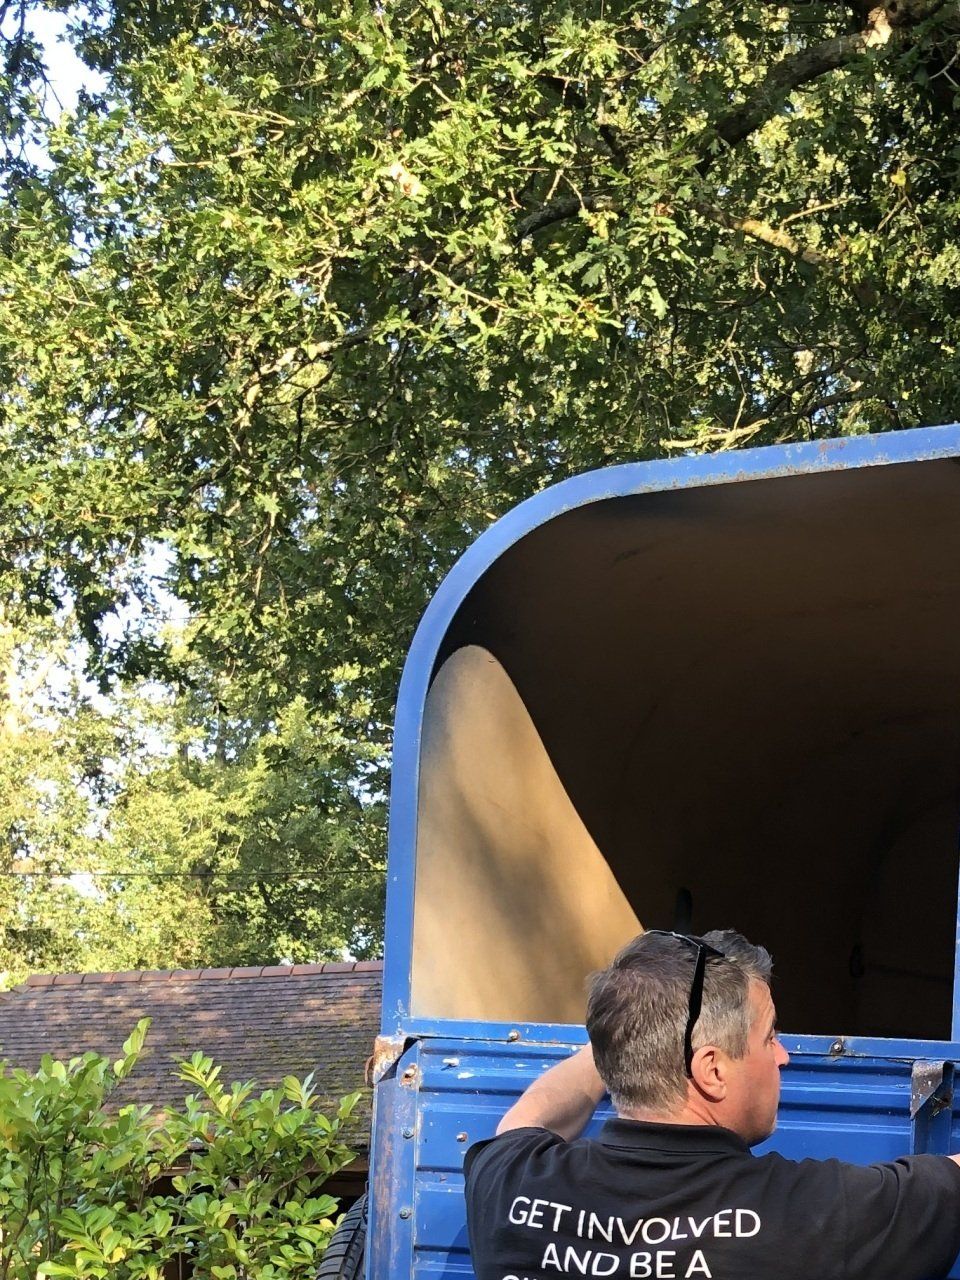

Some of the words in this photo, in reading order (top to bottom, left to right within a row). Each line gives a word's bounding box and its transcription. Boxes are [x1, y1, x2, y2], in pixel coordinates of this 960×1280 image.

[508, 1195, 573, 1232] GET
[577, 1208, 762, 1246] INVOLVED
[541, 1242, 620, 1277] AND
[629, 1250, 677, 1279] BE
[684, 1249, 713, 1279] A
